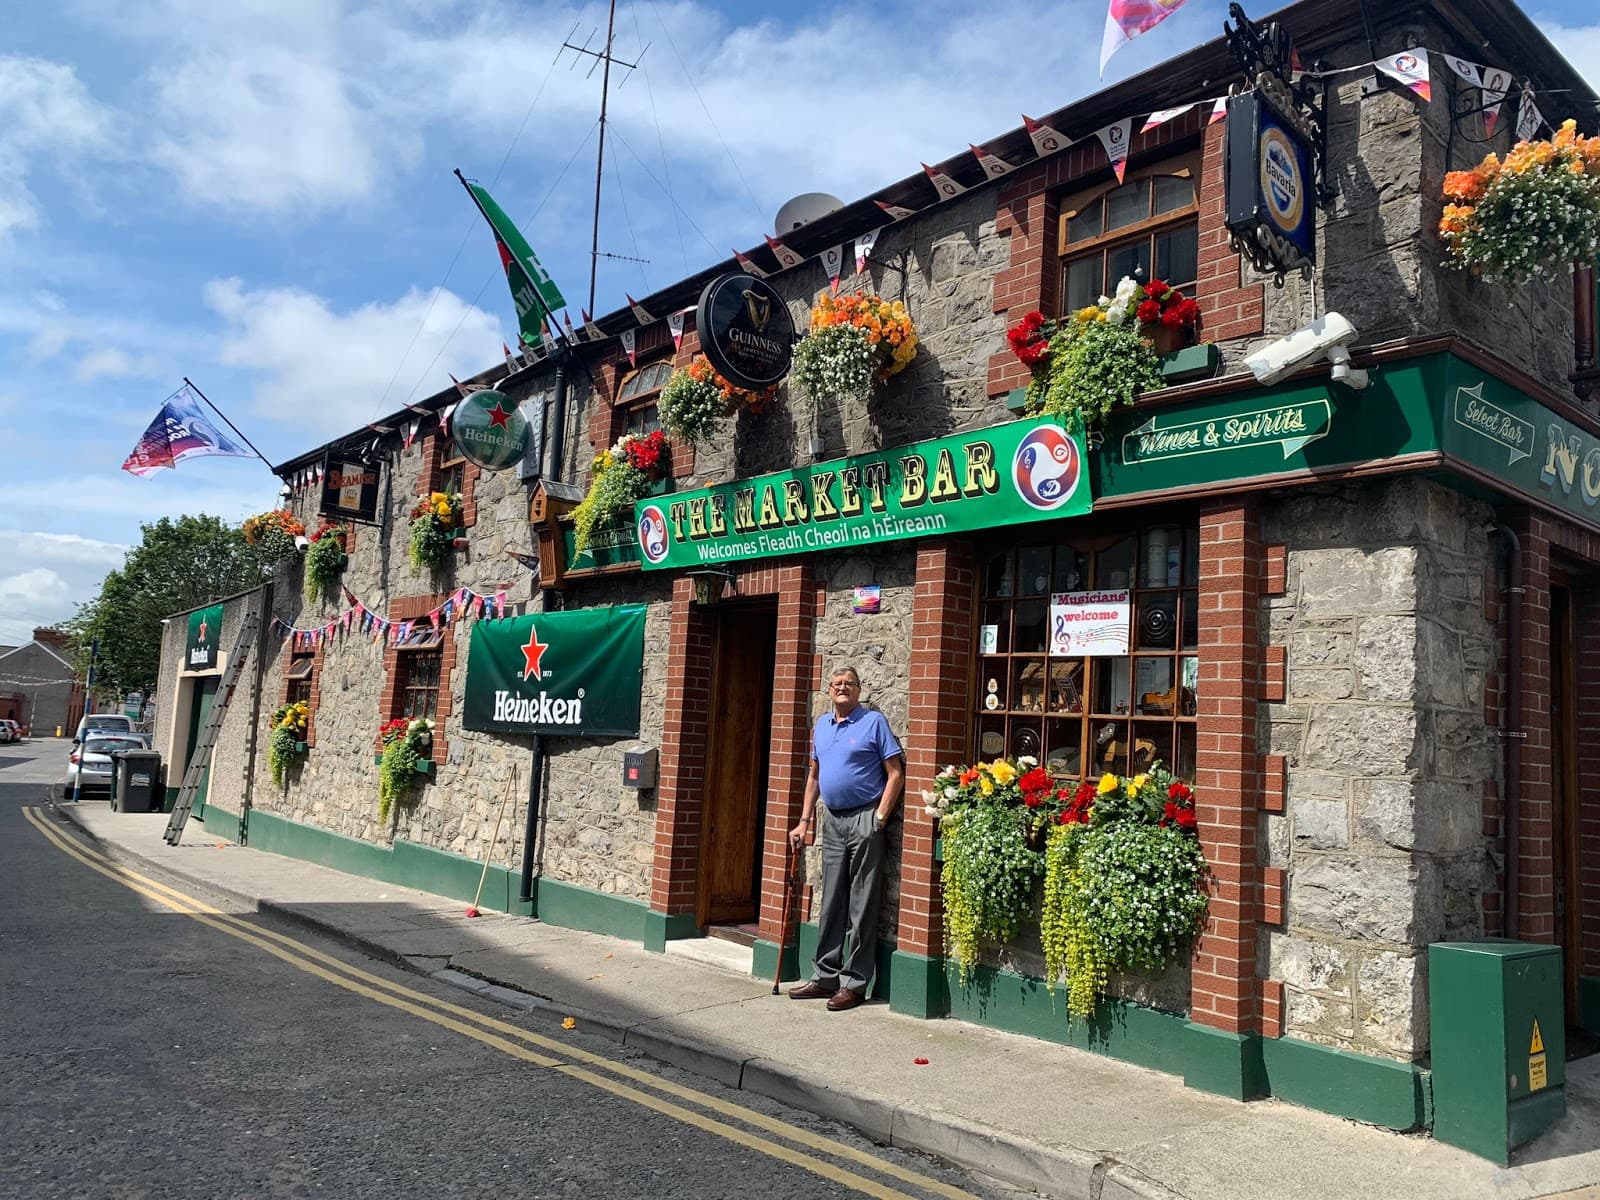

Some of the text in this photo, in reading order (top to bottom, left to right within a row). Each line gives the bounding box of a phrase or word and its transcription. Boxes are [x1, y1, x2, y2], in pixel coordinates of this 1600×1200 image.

[1265, 158, 1296, 198] Bavaria
[728, 327, 783, 354] GUINNESS
[464, 428, 524, 451] Heineken
[1138, 409, 1306, 455] Wines & Spirits
[1465, 400, 1524, 446] Select Bar
[670, 441, 1000, 544] THE MARKET BAR
[697, 513, 947, 561] Welcomes Fleadh Cheoil na hÉireann
[1063, 609, 1119, 622] welcome
[493, 689, 583, 724] Heineken
